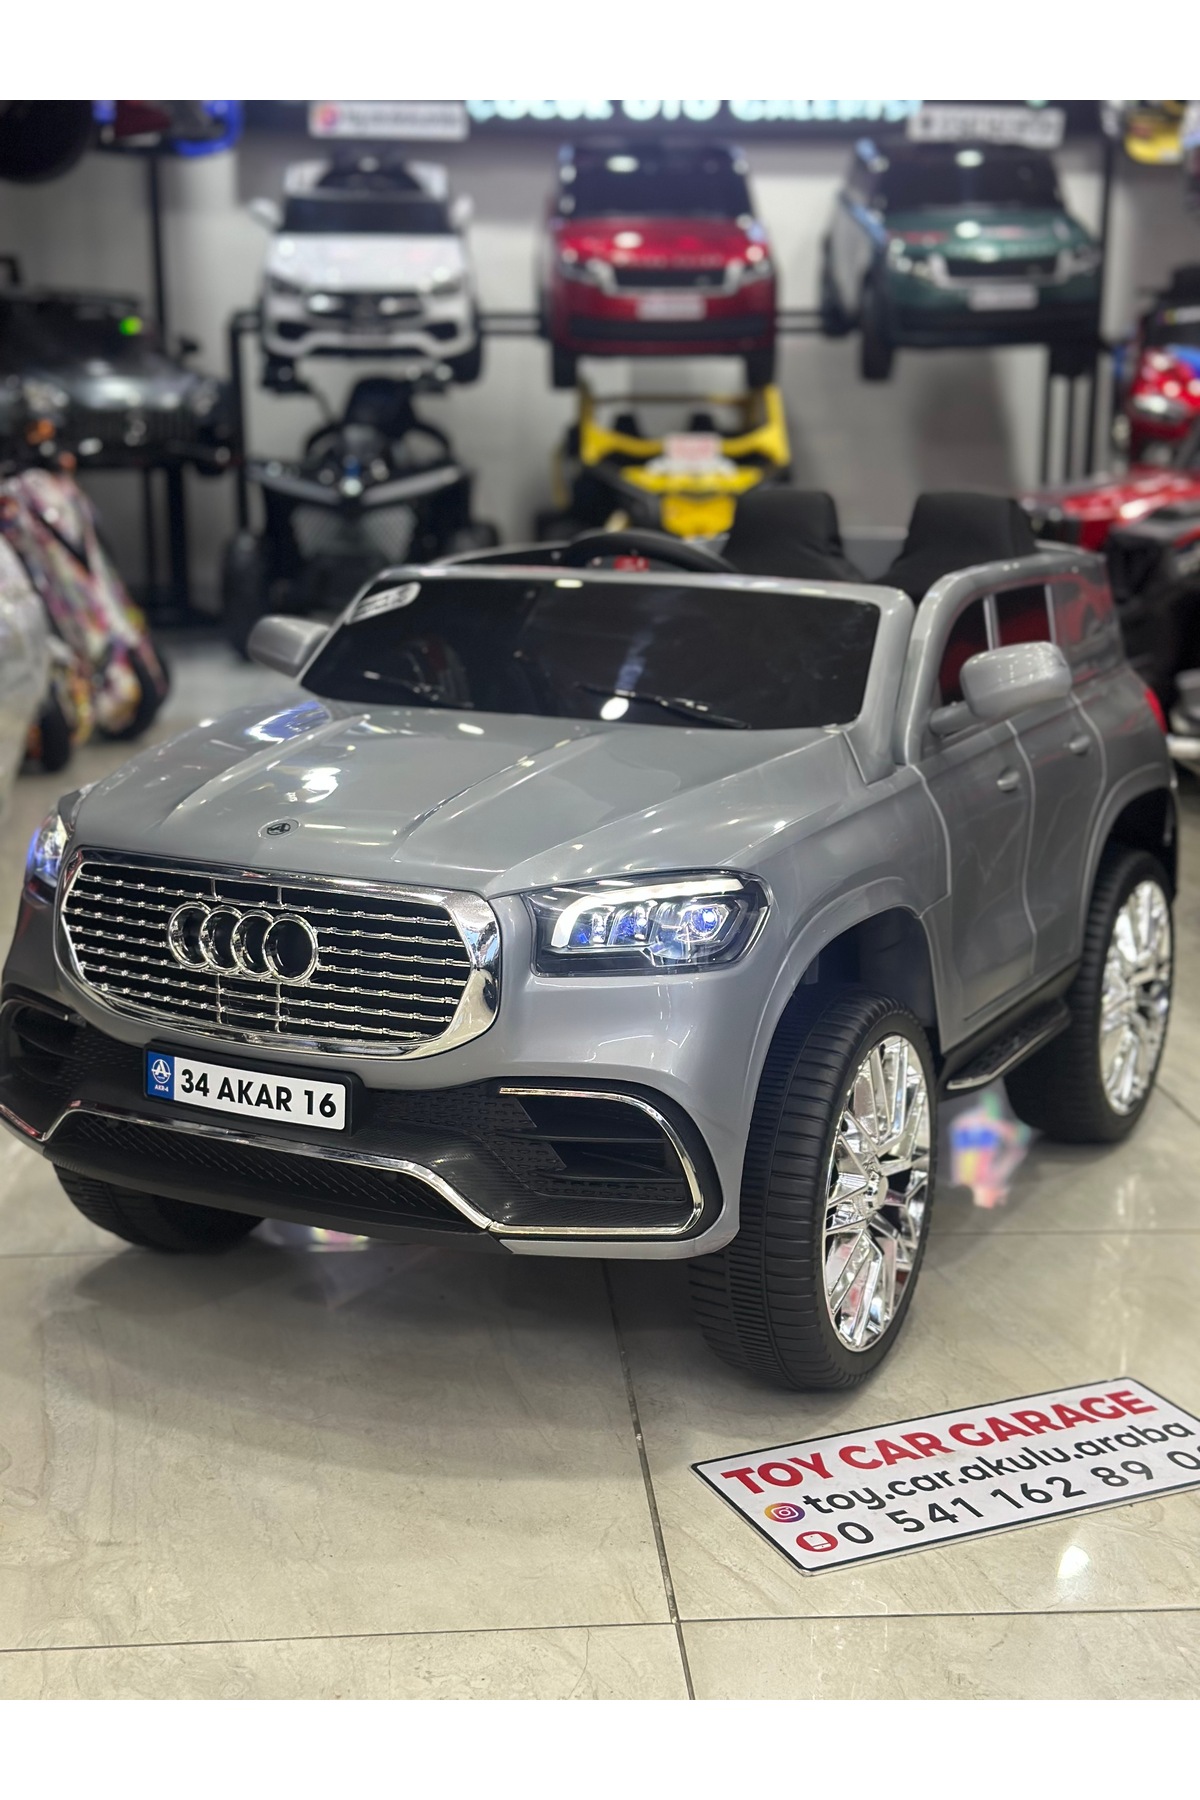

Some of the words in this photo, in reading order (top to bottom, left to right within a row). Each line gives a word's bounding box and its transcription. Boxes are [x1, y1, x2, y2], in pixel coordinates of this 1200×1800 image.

[181, 1069, 209, 1097] 34
[217, 1077, 292, 1112] AKAR
[304, 1090, 337, 1118] 16
[721, 1452, 833, 1495] TOY
[839, 1432, 959, 1470] CAR
[948, 1390, 1158, 1446] GARAGE
[803, 1423, 1196, 1515] toy.car.akulu.araba
[836, 1521, 875, 1544] 0
[886, 1496, 984, 1533] 541
[990, 1475, 1087, 1509] 162
[1090, 1460, 1153, 1487] 89
[1166, 1444, 1200, 1470] 0
